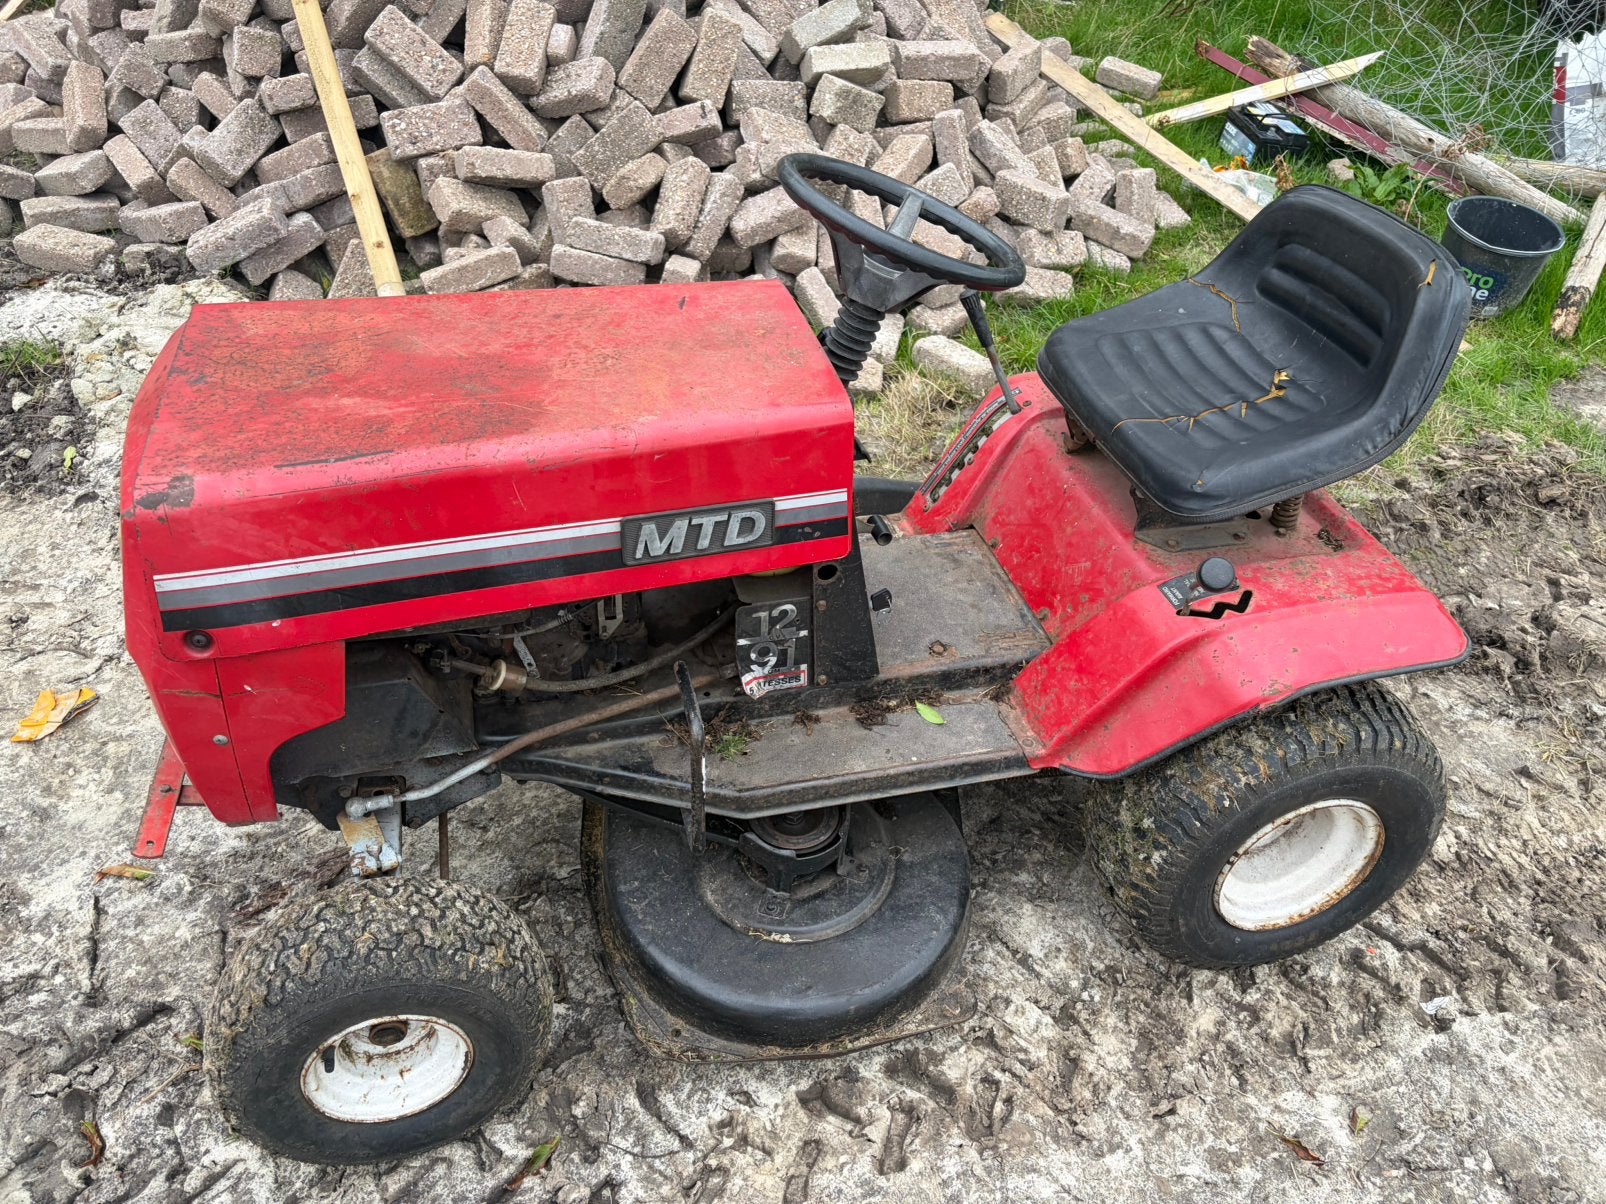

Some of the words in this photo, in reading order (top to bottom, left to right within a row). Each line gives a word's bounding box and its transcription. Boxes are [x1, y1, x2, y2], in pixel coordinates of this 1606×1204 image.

[635, 511, 766, 559] MTD
[1162, 586, 1180, 606] FORWARD
[752, 604, 797, 639] 12
[750, 639, 796, 673] 91
[749, 686, 755, 697] 5
